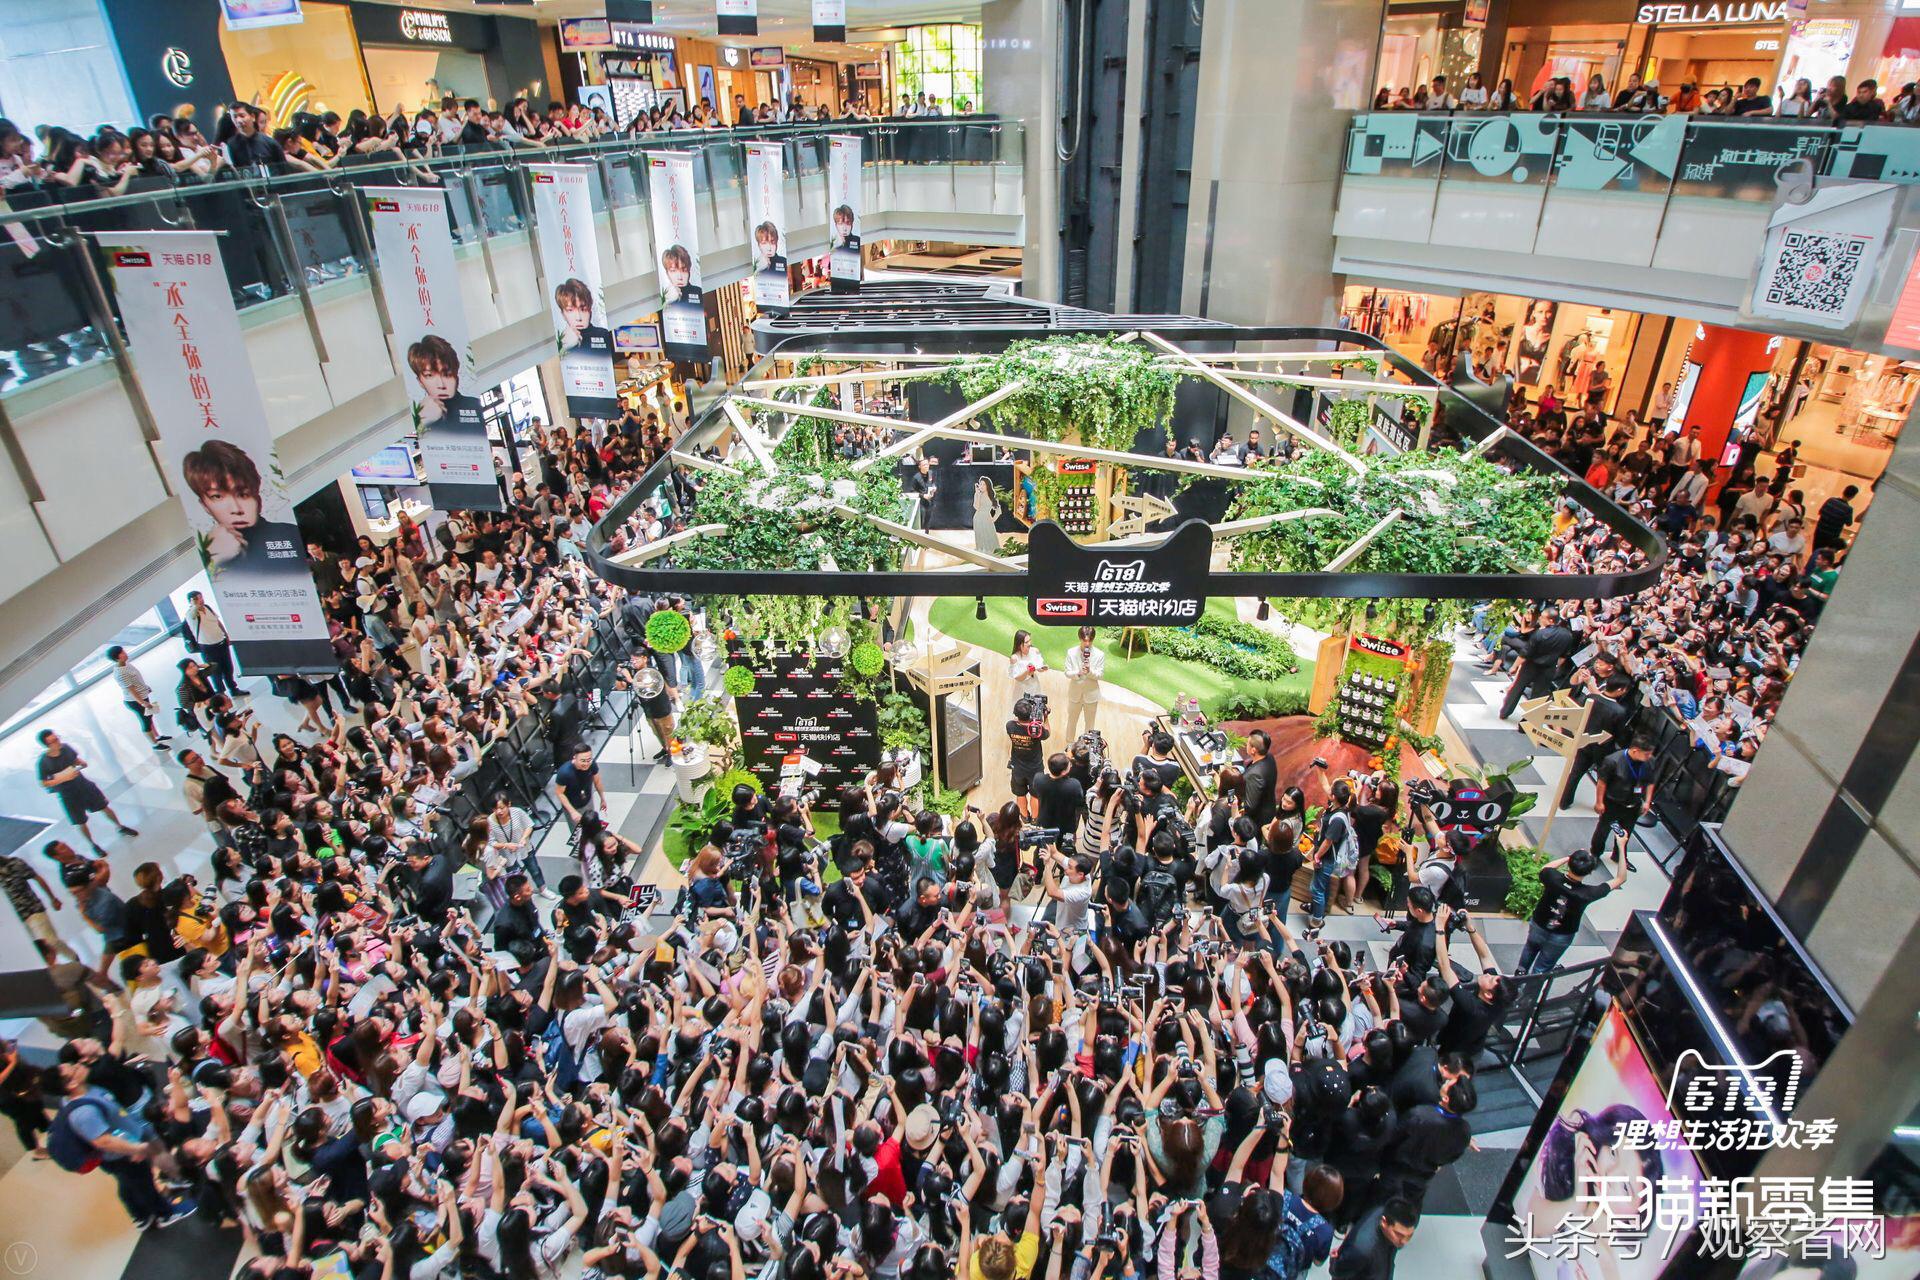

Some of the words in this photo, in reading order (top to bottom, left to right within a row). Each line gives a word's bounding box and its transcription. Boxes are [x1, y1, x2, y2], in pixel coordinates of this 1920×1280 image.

[1637, 5, 1721, 24] STELLA
[1724, 2, 1788, 22] LUNA
[120, 255, 147, 264] Swisse
[161, 253, 212, 266] 天猫618
[1064, 462, 1090, 471] Swisse
[1101, 568, 1136, 581] 618
[1064, 581, 1089, 593] 天猫
[1090, 581, 1171, 593] 理想生活狂欢季
[223, 590, 249, 598] Swisse
[1045, 602, 1078, 612] Swisse
[1099, 598, 1198, 616] 天猫快闪店
[1360, 637, 1399, 656] Swisse
